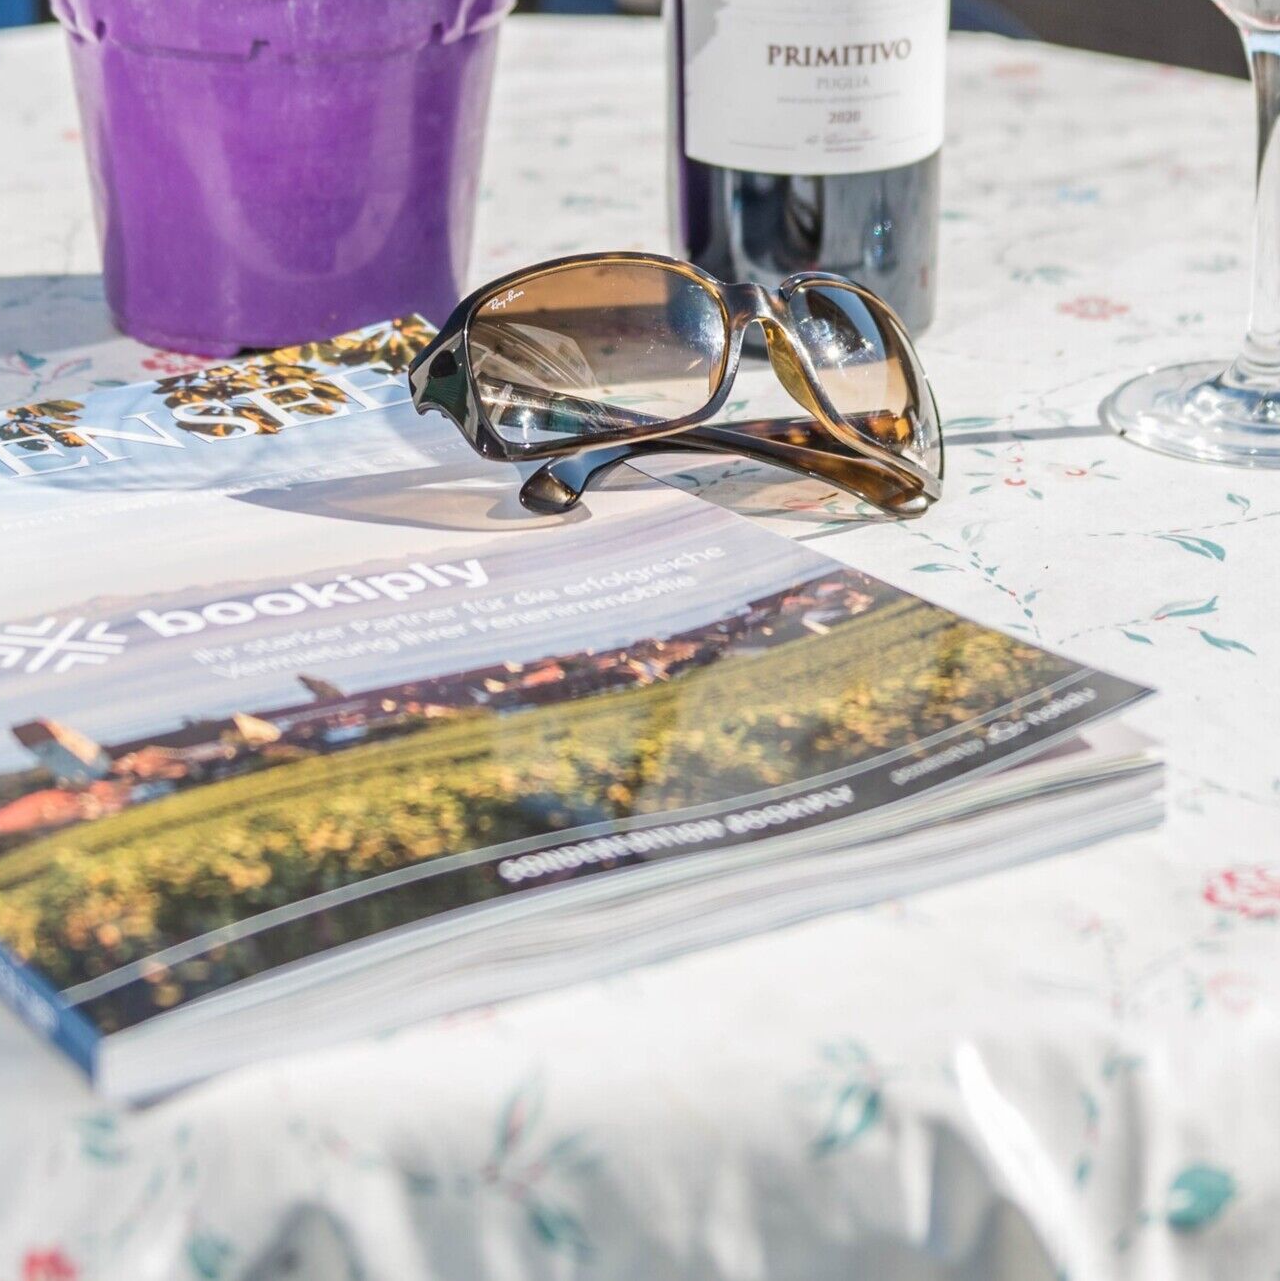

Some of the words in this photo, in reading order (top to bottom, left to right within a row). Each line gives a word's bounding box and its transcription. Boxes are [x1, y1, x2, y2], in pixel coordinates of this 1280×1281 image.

[767, 39, 912, 67] PRIMITIVO
[816, 76, 871, 90] PUGLIA
[487, 289, 524, 310] Ray-Ban
[136, 558, 489, 637] bookiply
[192, 645, 235, 665] Ihr
[243, 625, 345, 653] starker
[351, 605, 458, 634] Partner
[461, 595, 507, 616] für
[513, 587, 559, 606] die
[563, 545, 726, 596] erfolgreiche
[212, 634, 401, 679] Vermietung
[470, 573, 698, 633] Ferienimmobilie
[499, 818, 724, 882] SONDEREDITION
[725, 784, 855, 834] BOOKIPLY
